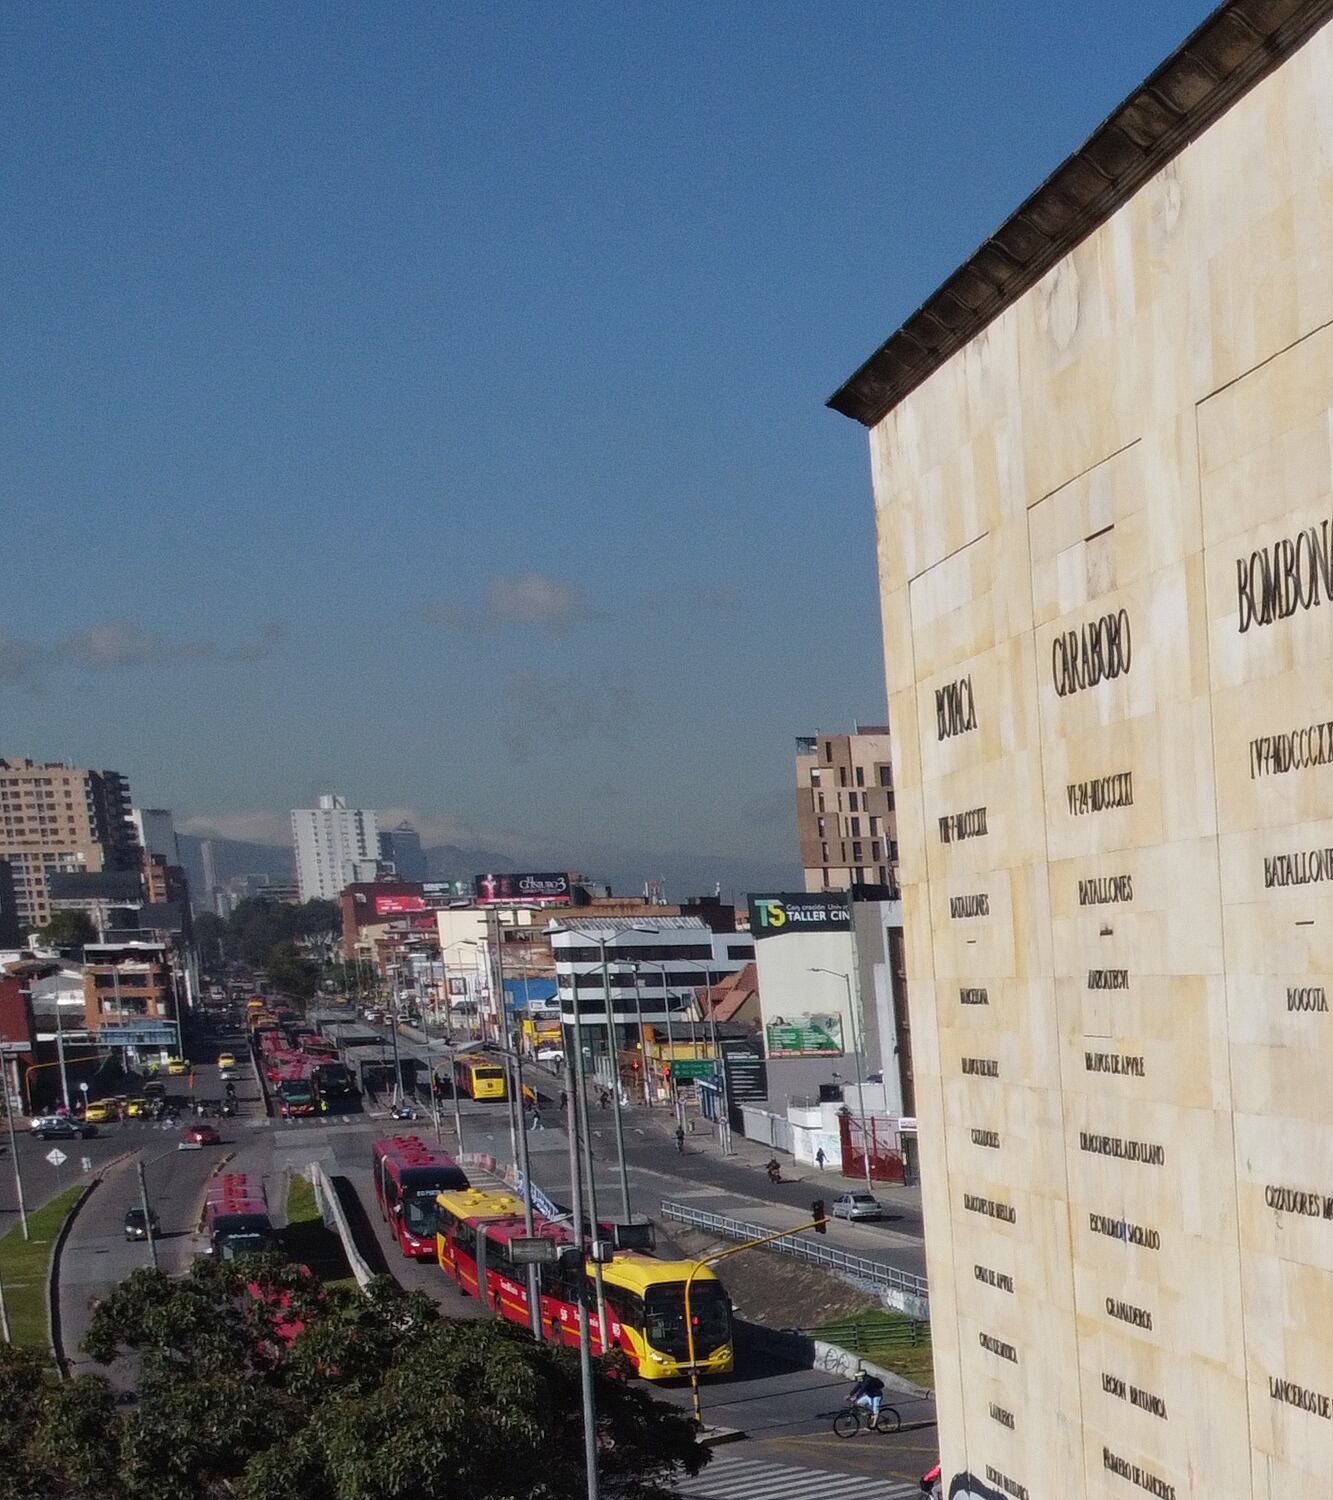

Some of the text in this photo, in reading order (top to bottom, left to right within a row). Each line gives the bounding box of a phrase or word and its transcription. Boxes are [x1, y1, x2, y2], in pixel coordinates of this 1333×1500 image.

[1053, 608, 1132, 697] CARABOBO
[1078, 874, 1133, 906] BATALLONES
[787, 911, 826, 921] TALLER
[1287, 987, 1329, 1012] BOGOTA
[1265, 1185, 1320, 1217] CAZADORES
